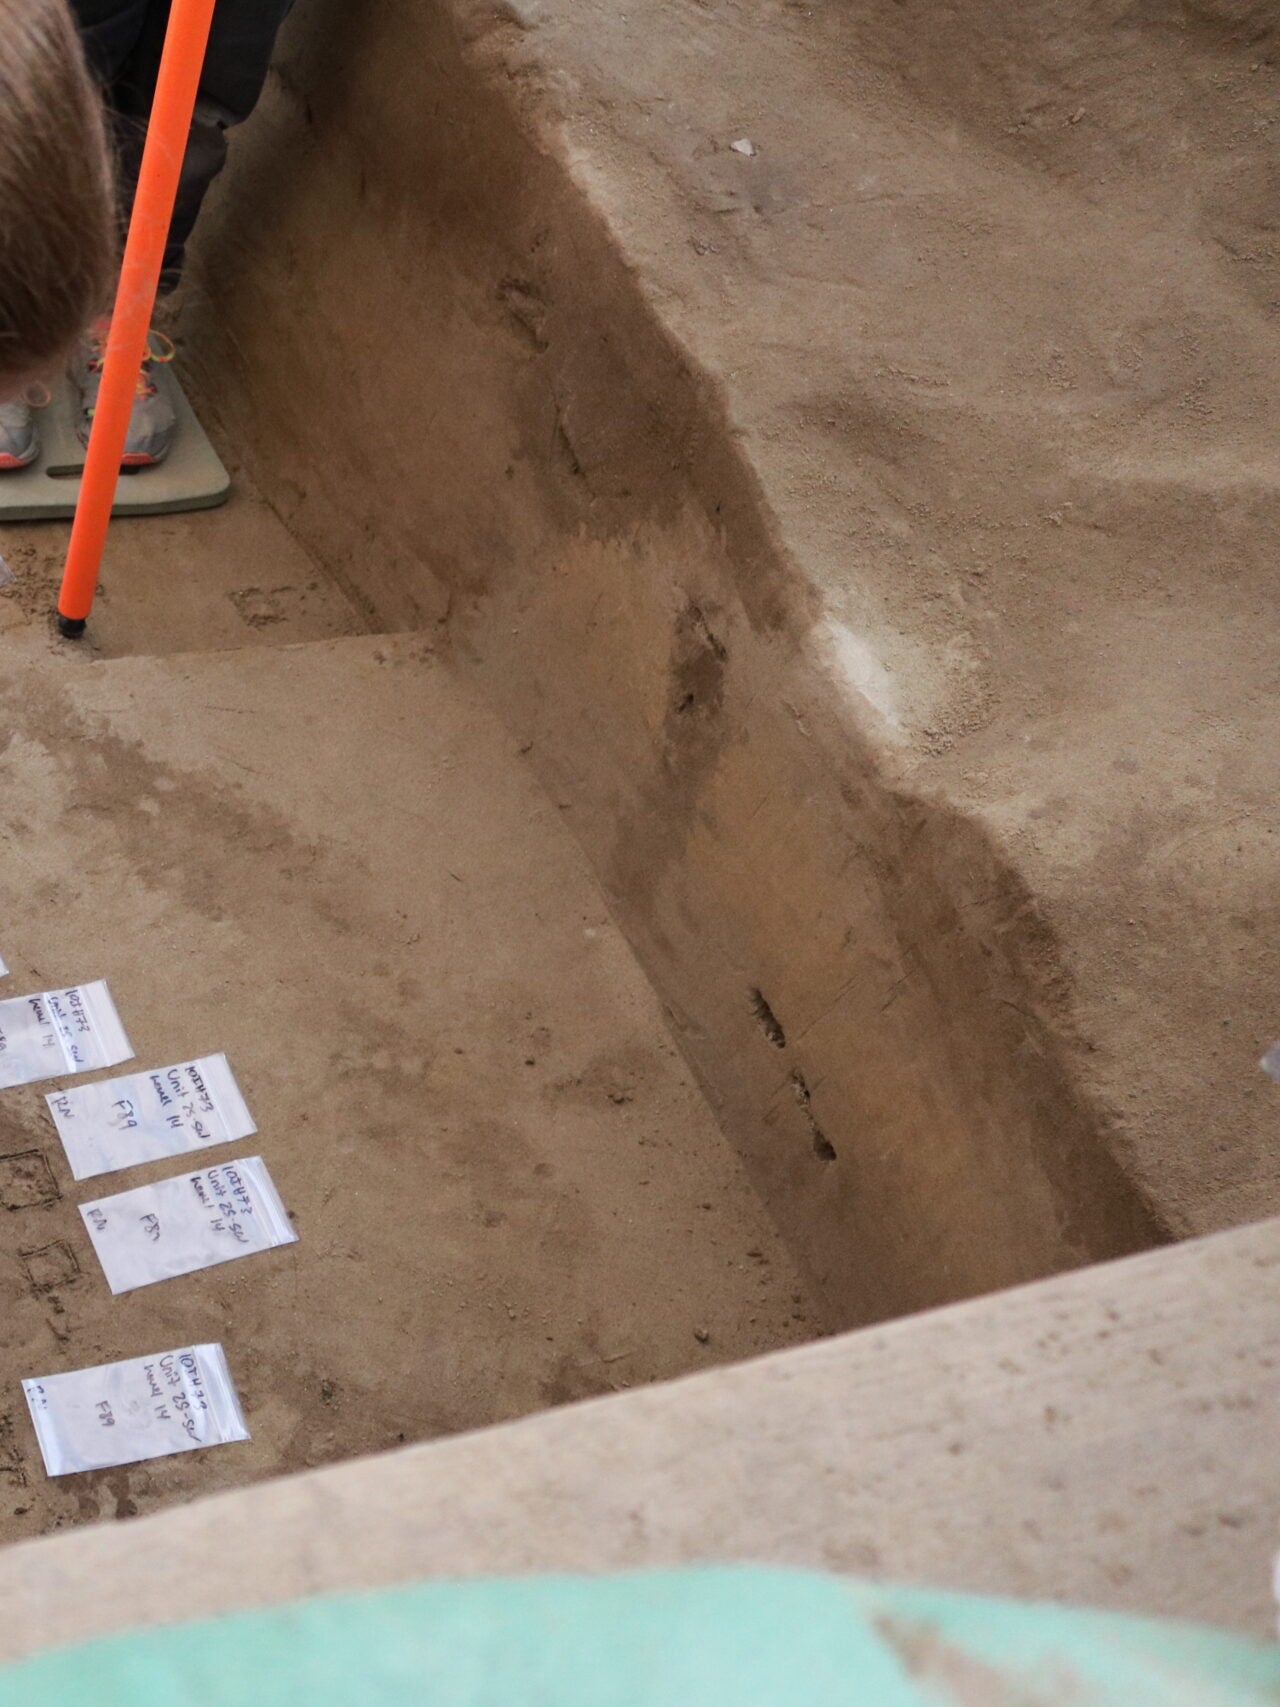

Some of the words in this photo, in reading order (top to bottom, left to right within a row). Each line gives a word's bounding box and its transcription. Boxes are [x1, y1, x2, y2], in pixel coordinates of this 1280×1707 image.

[42, 1035, 54, 1048] 14
[167, 1069, 186, 1097] Unit
[166, 1116, 183, 1128] 14
[207, 1170, 225, 1196] Unit
[208, 1219, 225, 1231] 14
[159, 1355, 178, 1386] Unit
[153, 1405, 171, 1419] 14
